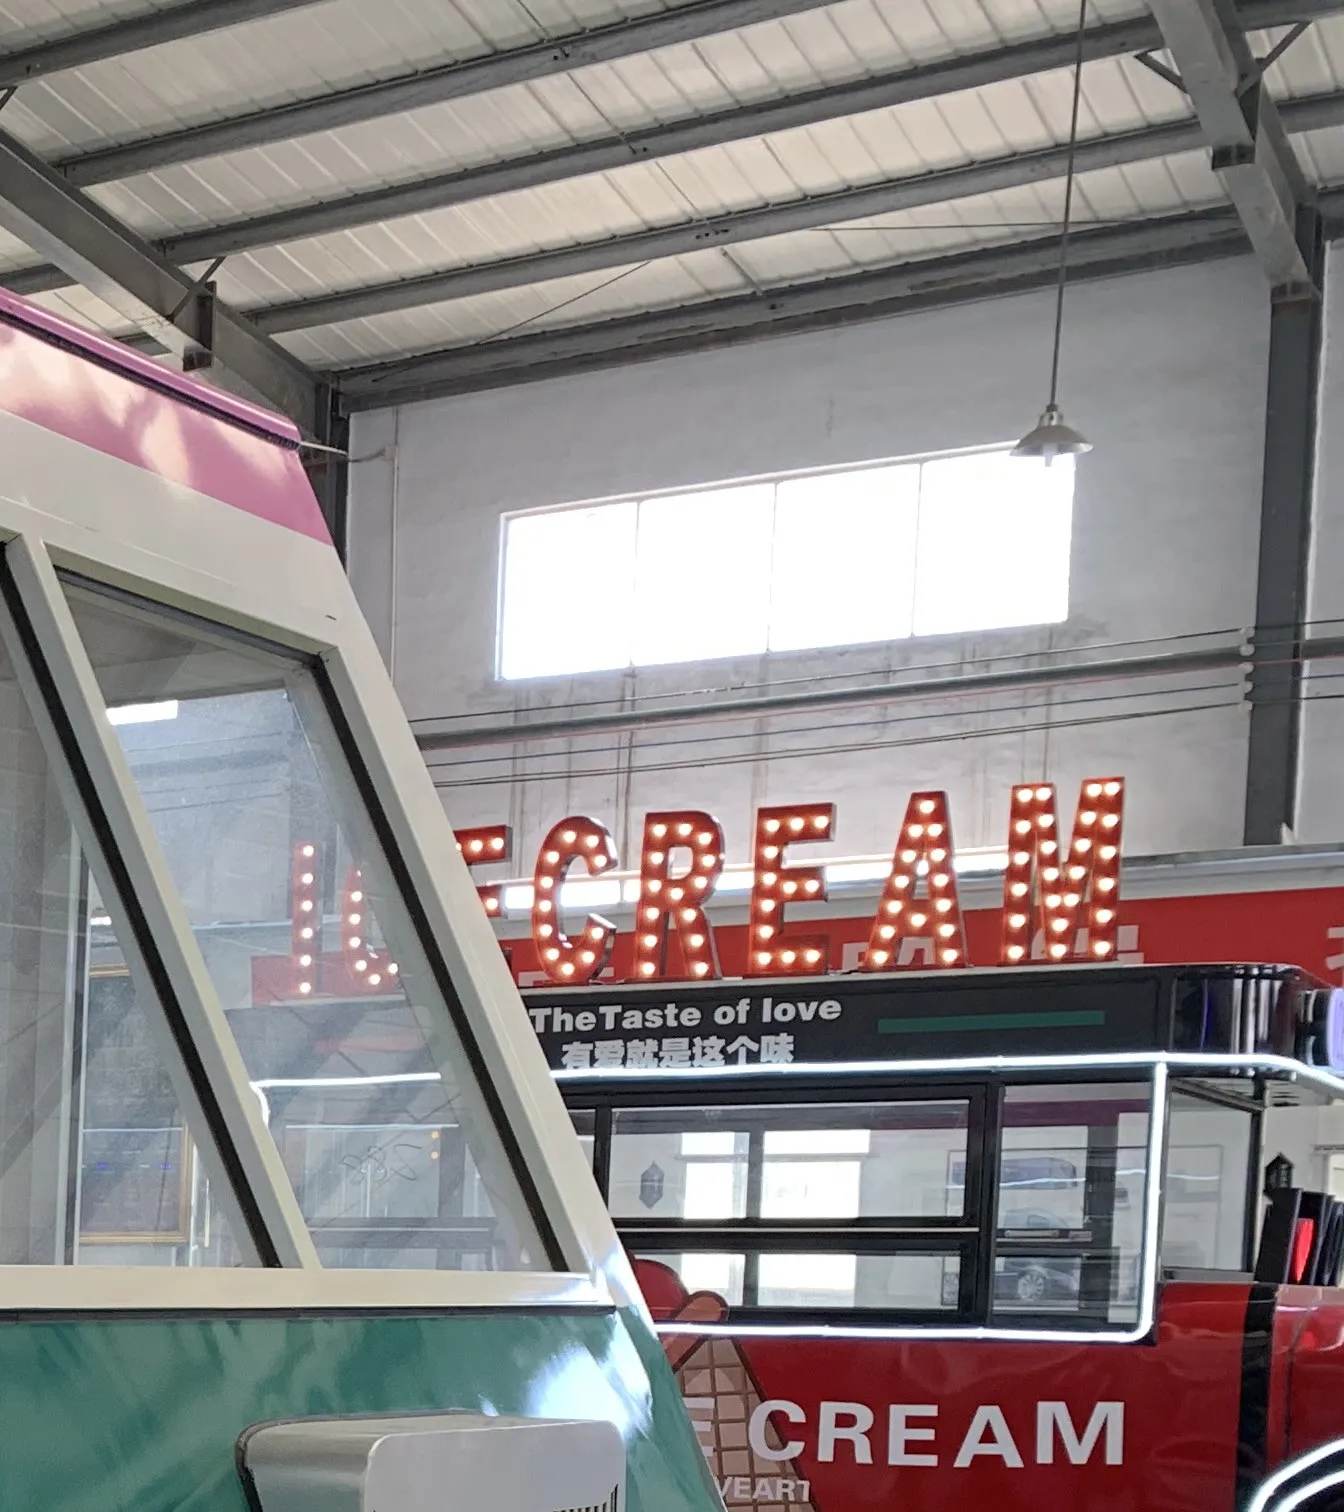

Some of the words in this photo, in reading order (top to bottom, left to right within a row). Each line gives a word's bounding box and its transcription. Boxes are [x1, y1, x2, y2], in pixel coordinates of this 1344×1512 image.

[713, 998, 751, 1026] of
[761, 997, 842, 1024] love
[747, 1399, 1125, 1468] CREAM
